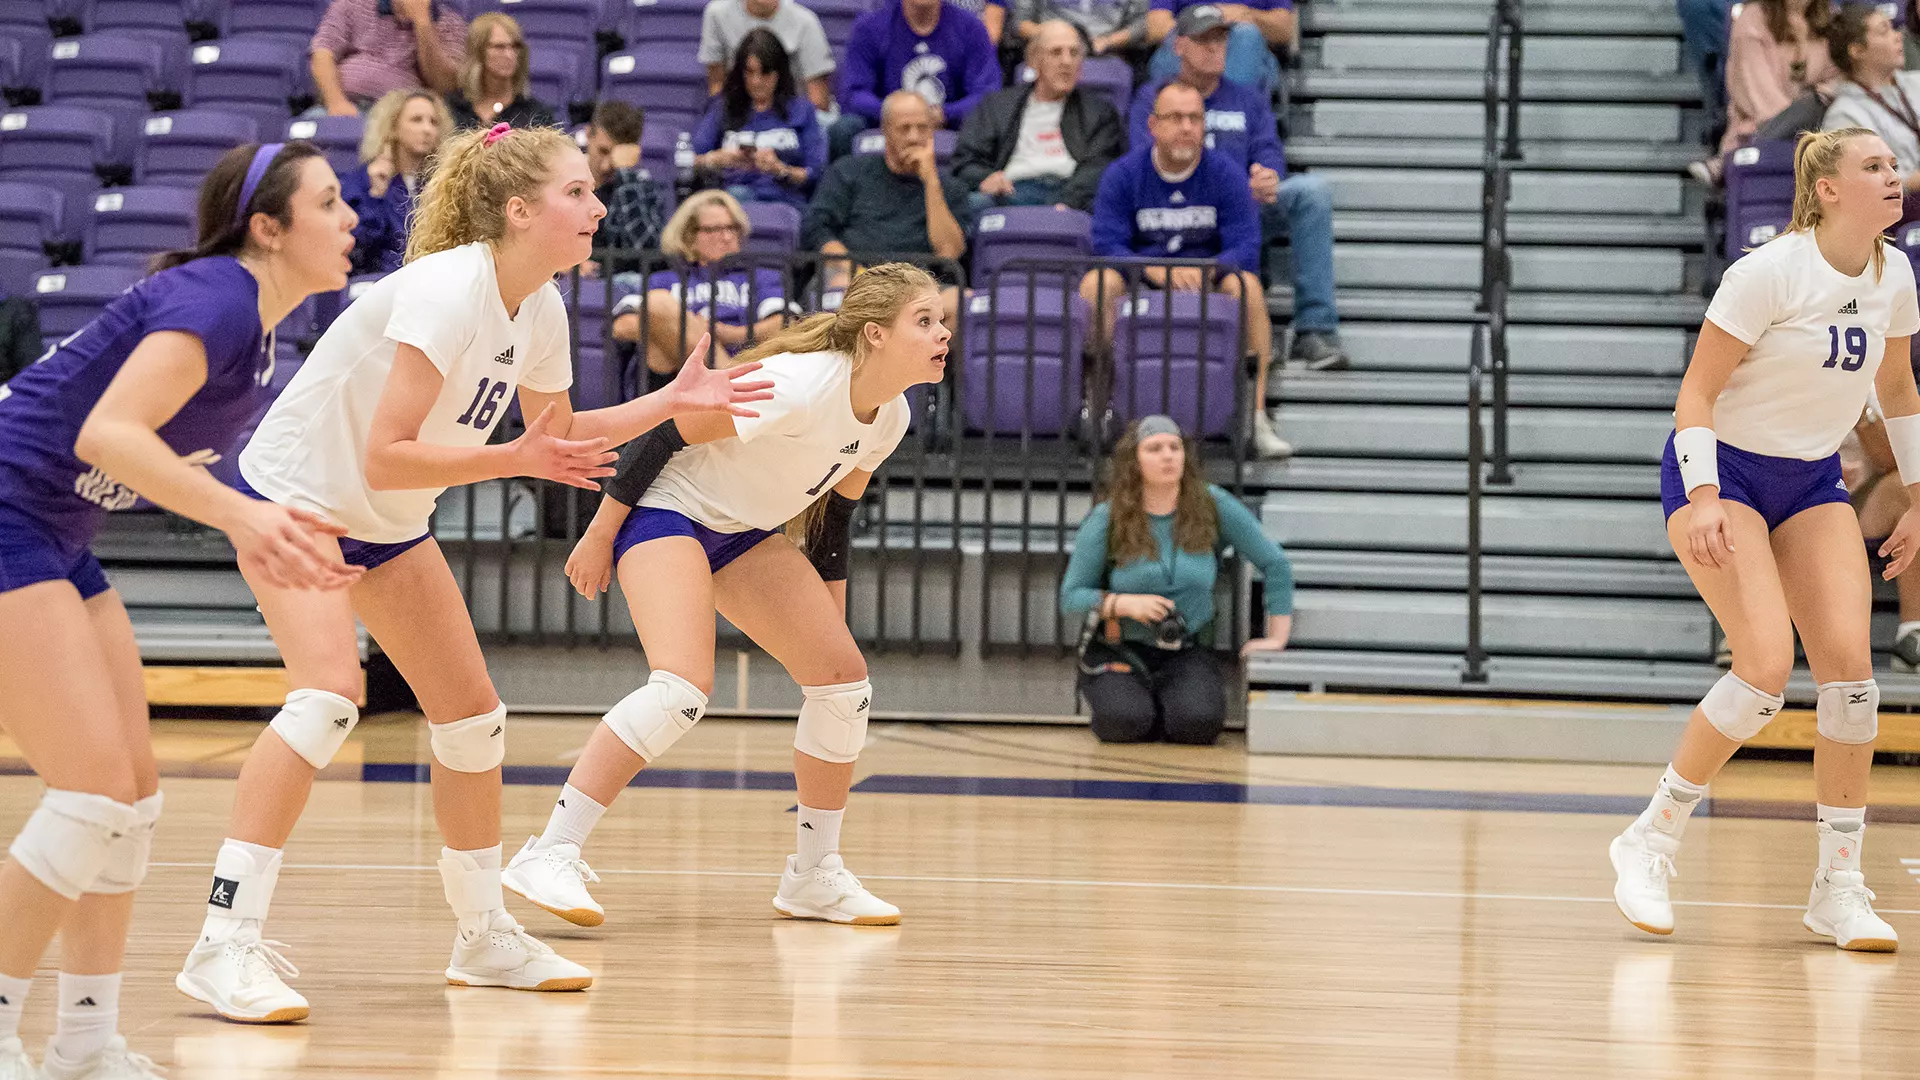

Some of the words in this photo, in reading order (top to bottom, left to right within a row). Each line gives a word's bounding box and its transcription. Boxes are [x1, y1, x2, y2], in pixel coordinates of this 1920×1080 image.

[1822, 325, 1867, 372] 19
[456, 377, 507, 430] 16
[805, 463, 842, 496] 1
